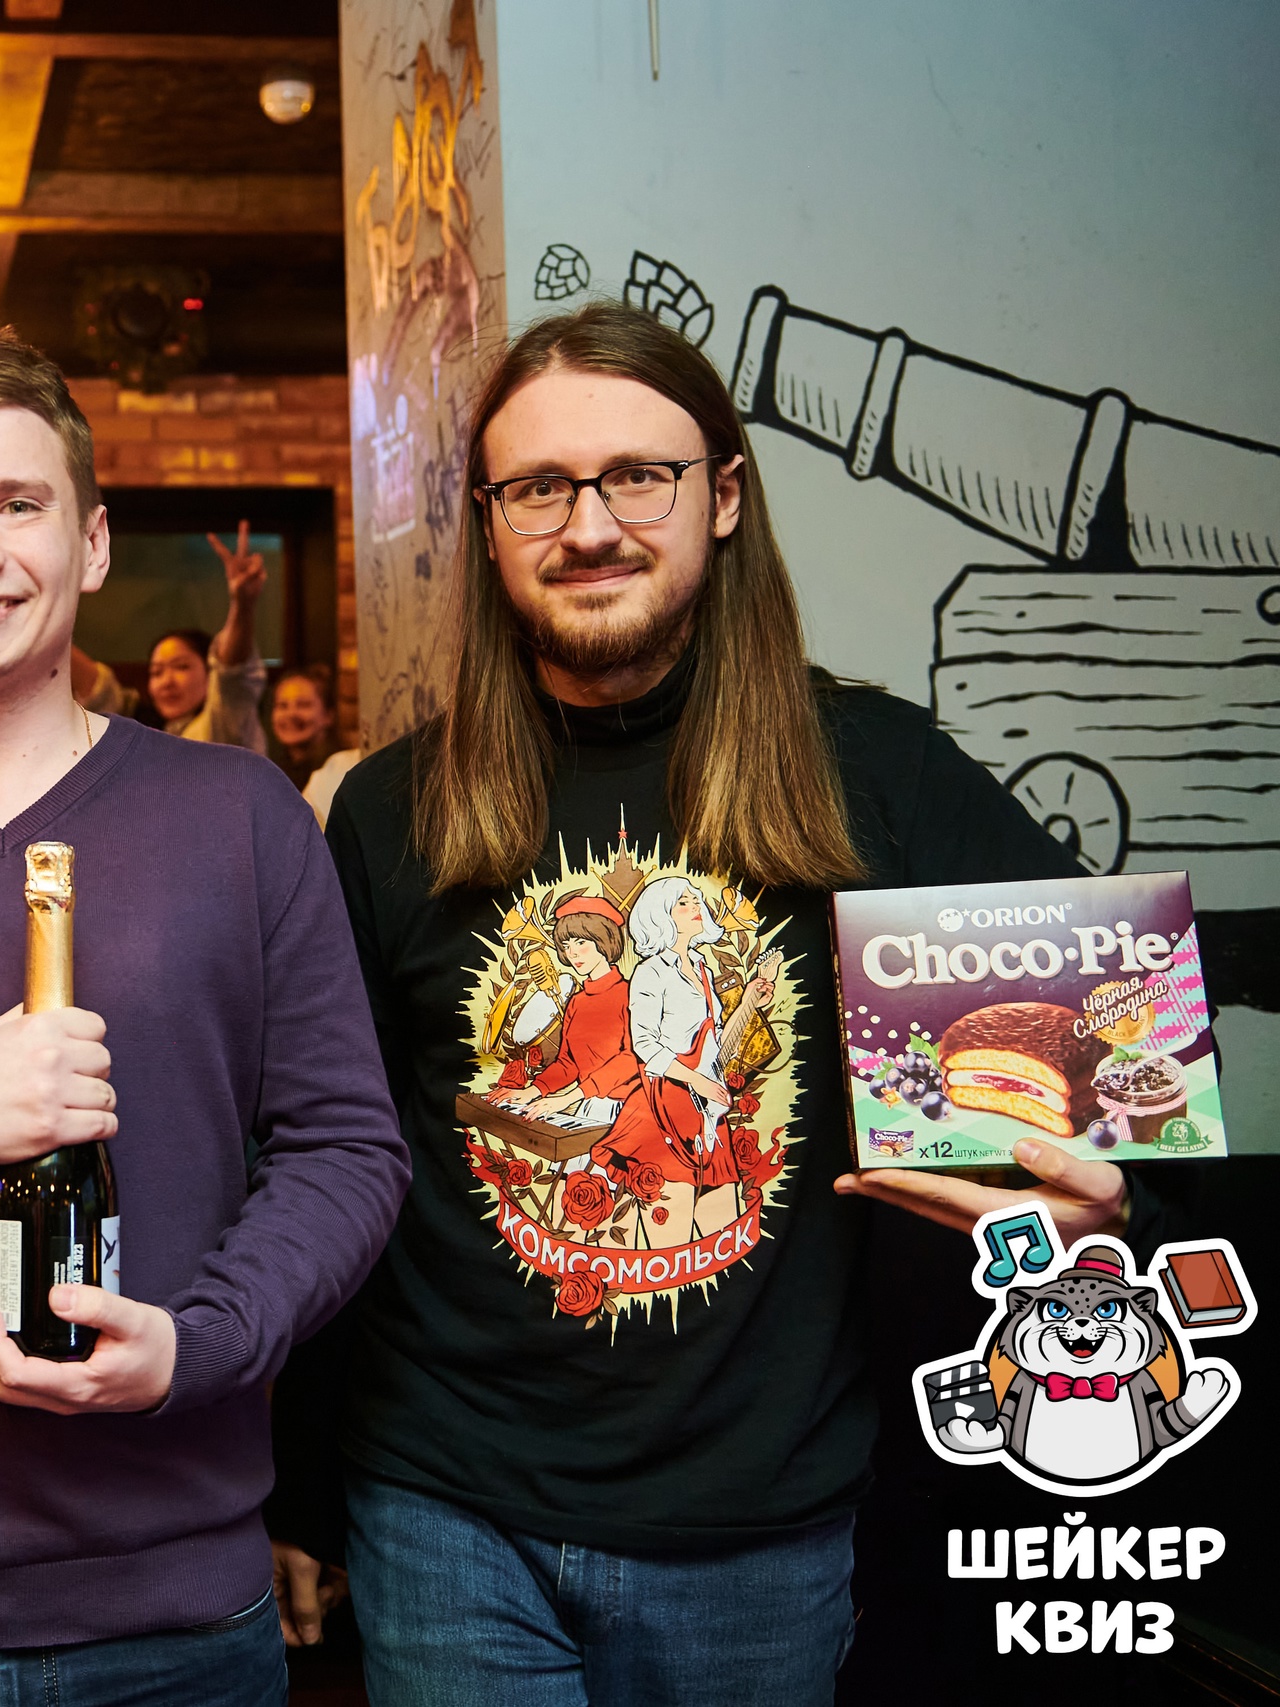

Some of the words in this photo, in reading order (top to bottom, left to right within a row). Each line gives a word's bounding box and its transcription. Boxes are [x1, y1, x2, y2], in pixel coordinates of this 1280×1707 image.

[971, 905, 1066, 928] ORION
[1073, 980, 1168, 1039] Смородина
[1082, 976, 1144, 1014] Чёрная
[955, 1150, 979, 1160] ШТУК
[979, 1149, 993, 1158] NET
[1176, 1142, 1206, 1153] GELATIN
[501, 1202, 755, 1284] КОМСОМОЛЬСК
